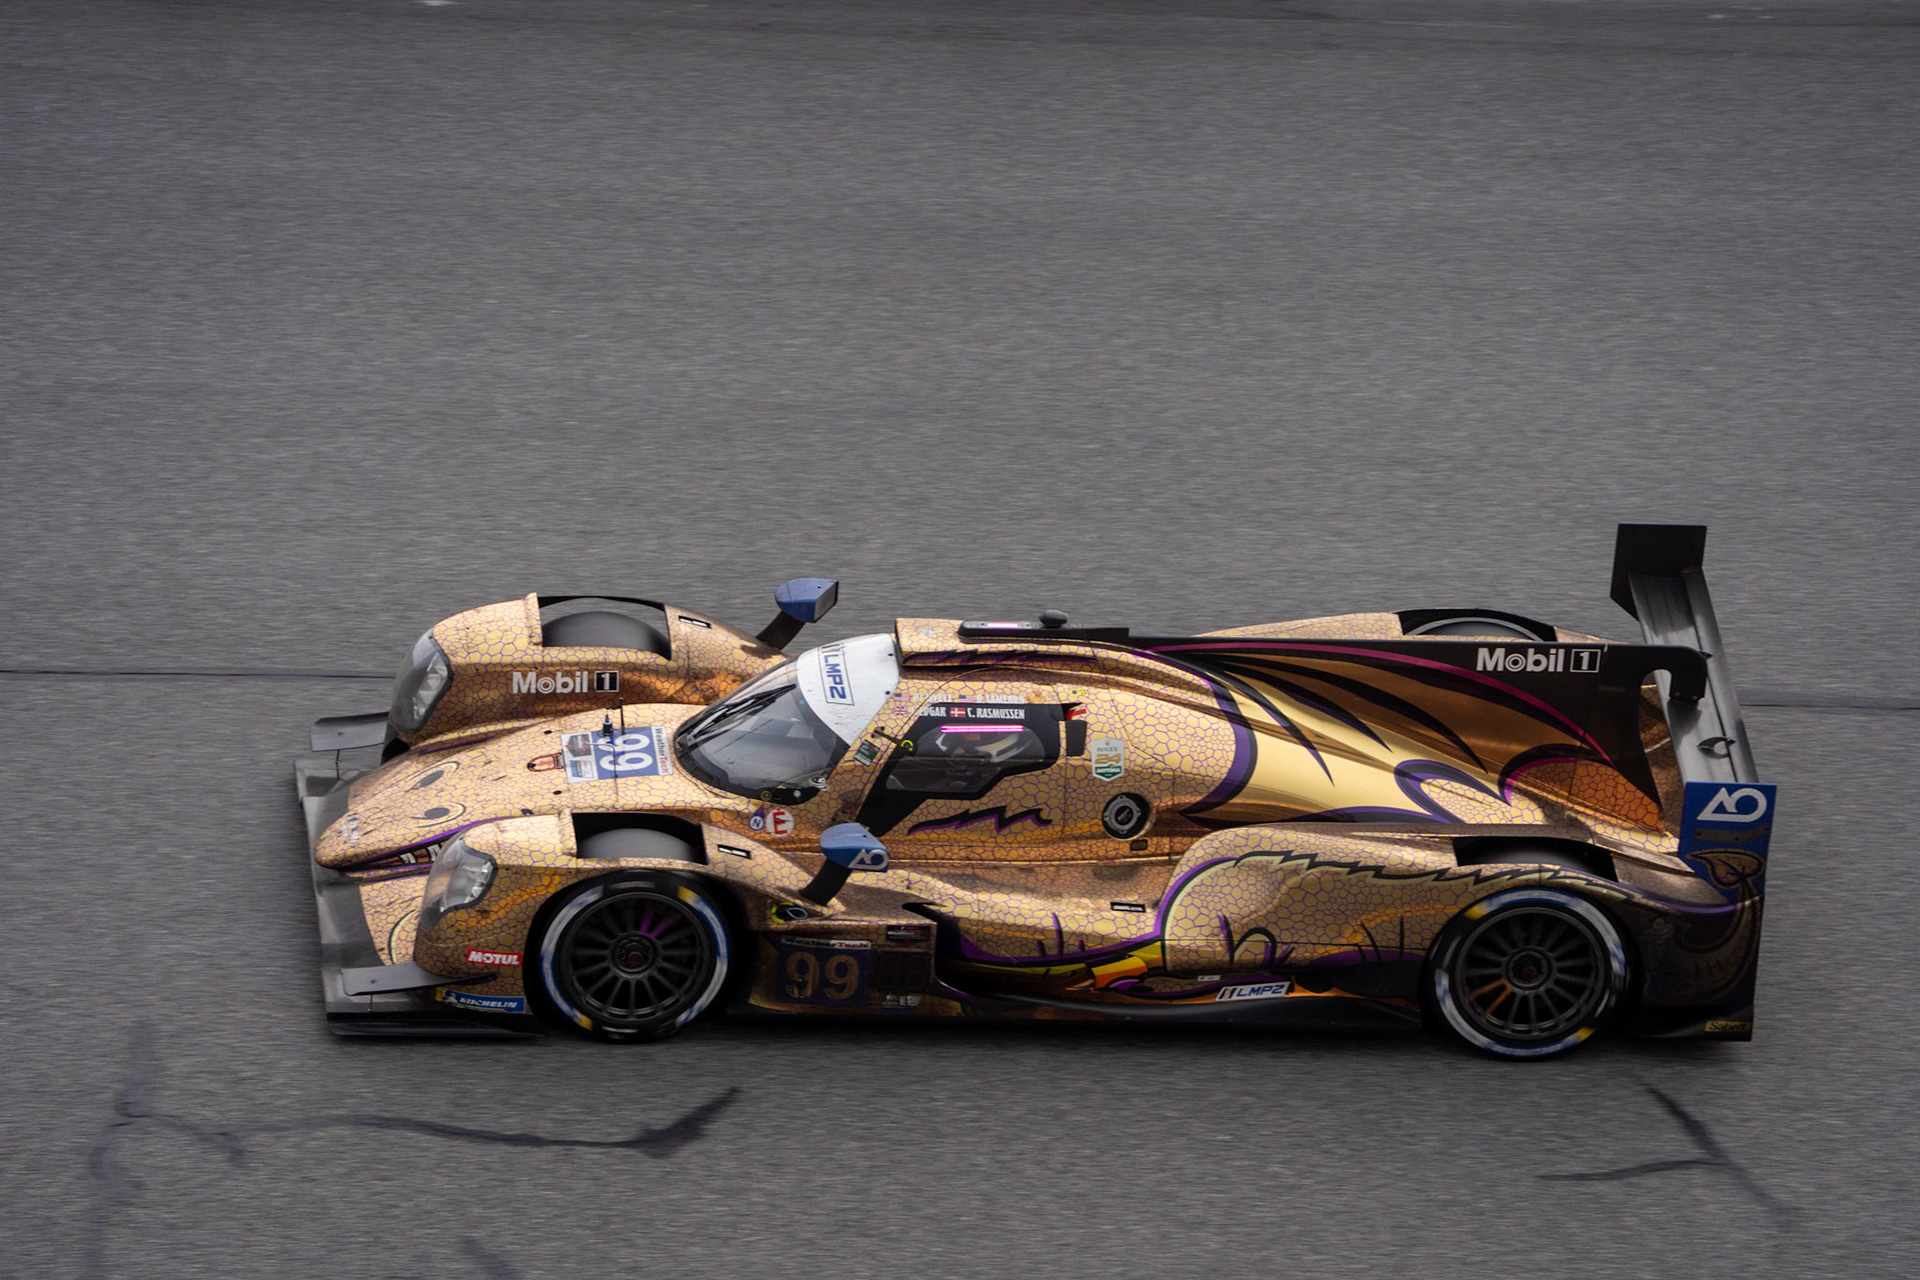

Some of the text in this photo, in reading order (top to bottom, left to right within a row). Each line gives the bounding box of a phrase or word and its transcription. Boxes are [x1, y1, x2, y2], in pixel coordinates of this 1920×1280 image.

[1476, 648, 1565, 672] Mobil
[512, 671, 589, 694] Mobil
[824, 654, 847, 699] LMP2
[919, 706, 947, 717] EDGAR
[966, 707, 1025, 719] C. RASMUSSEN
[596, 733, 653, 771] 99
[655, 728, 669, 773] WeatherTech
[1094, 753, 1122, 764] 24
[773, 811, 788, 835] E
[784, 936, 870, 948] WeatherTech
[468, 951, 520, 965] MOTUL
[785, 951, 860, 1001] 99
[1236, 984, 1285, 997] LMP2
[459, 997, 518, 1008] MICHELIN
